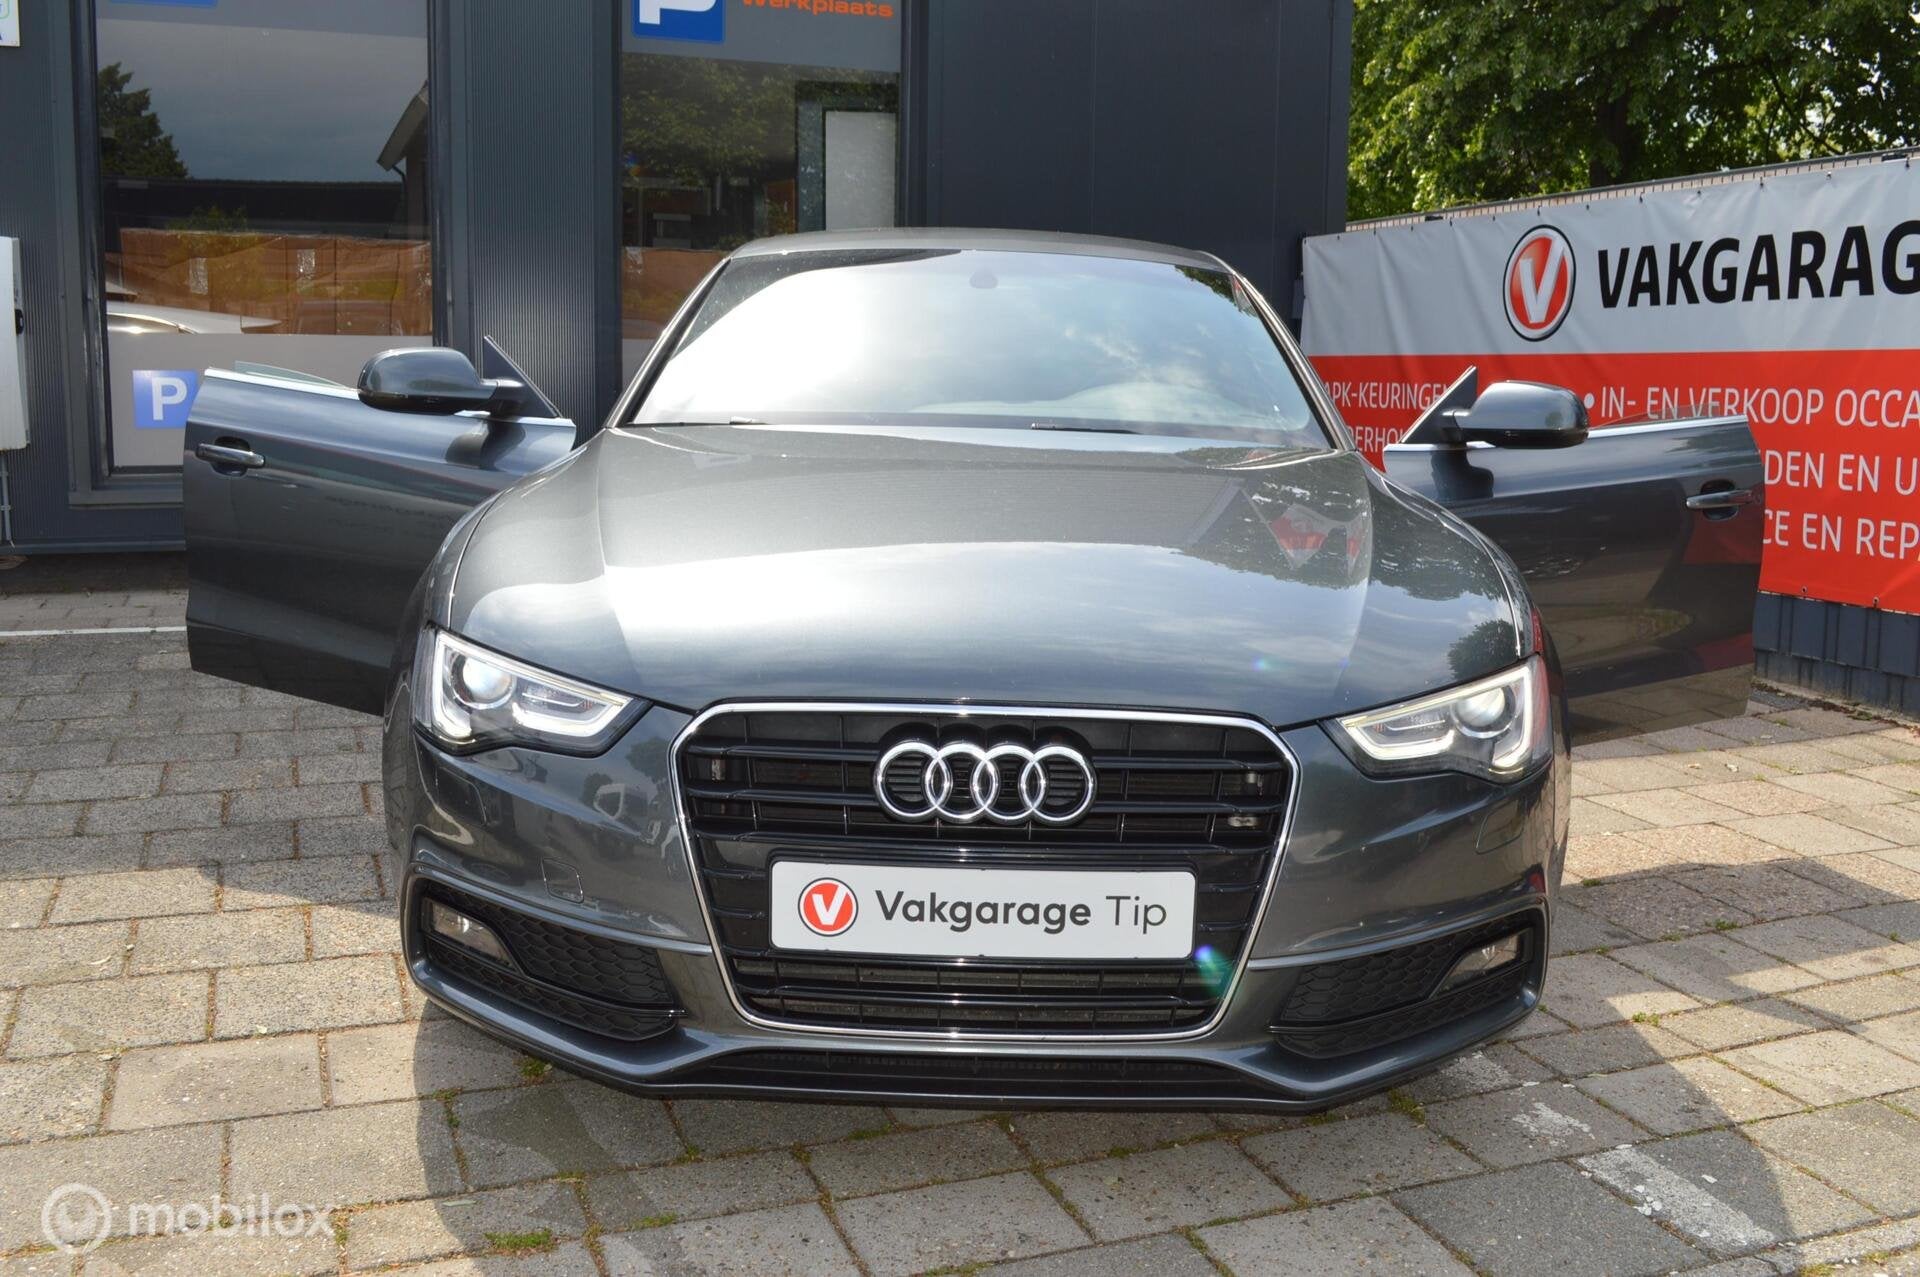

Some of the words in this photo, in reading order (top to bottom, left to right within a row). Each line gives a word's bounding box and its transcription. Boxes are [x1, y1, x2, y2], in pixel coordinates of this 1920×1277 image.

[1597, 220, 1920, 309] VAKGARAG
[151, 376, 188, 421] P
[1600, 386, 1637, 418] IN-
[1646, 386, 1680, 420] EN
[1688, 387, 1824, 425] VERKOOP
[1838, 454, 1880, 494] EN
[1802, 513, 1842, 553] EN
[875, 889, 1092, 935] Vakgarage
[1105, 894, 1167, 935] Tip
